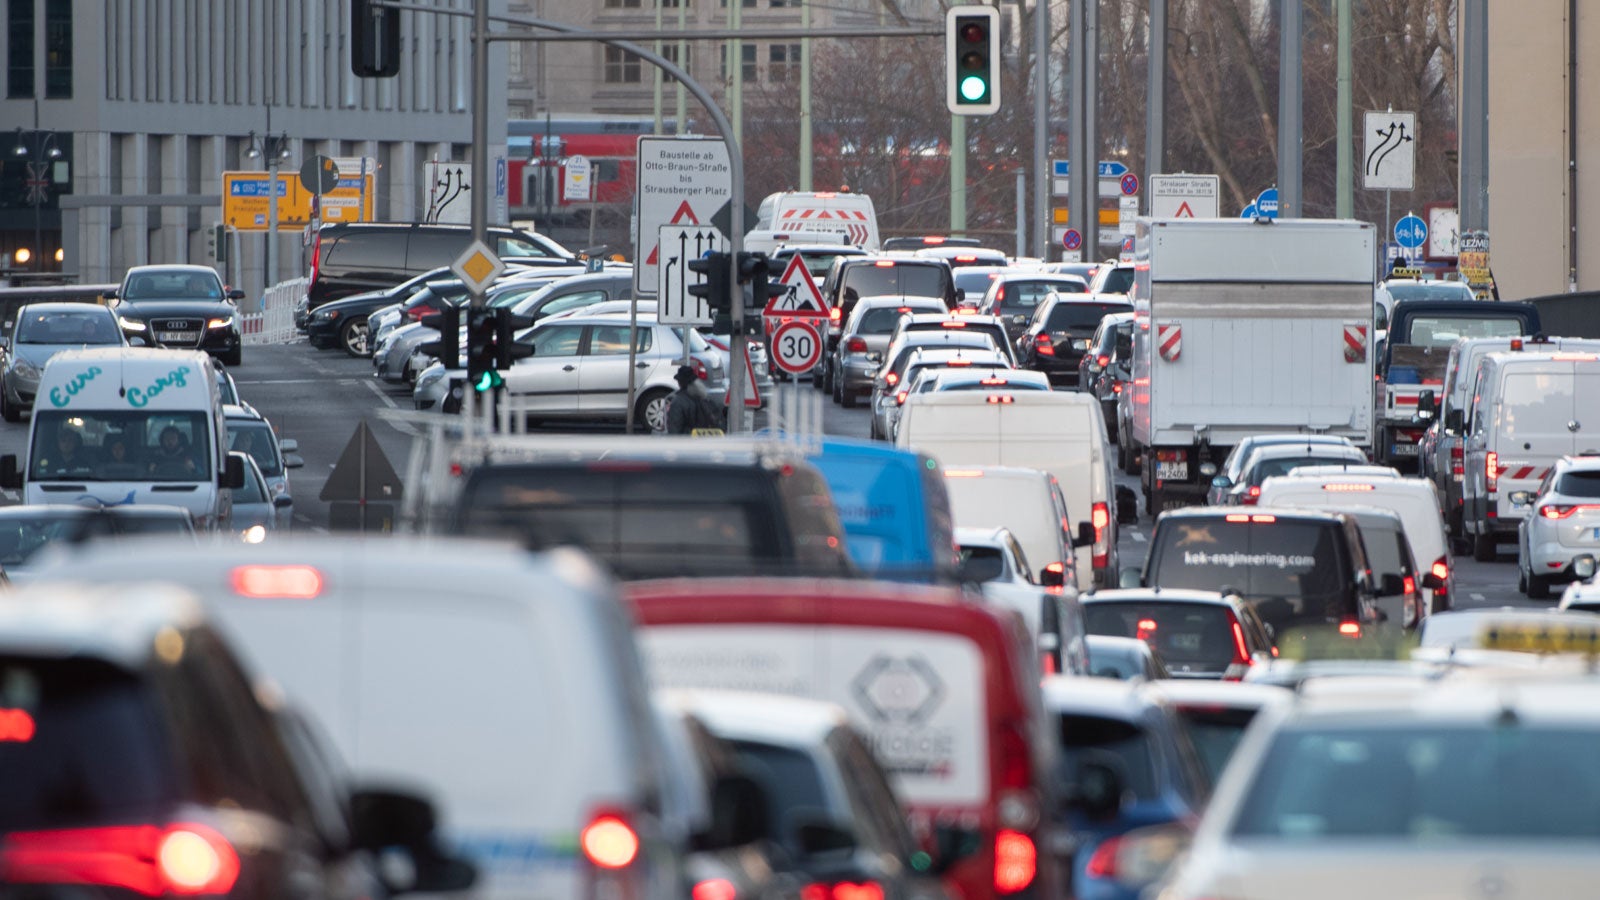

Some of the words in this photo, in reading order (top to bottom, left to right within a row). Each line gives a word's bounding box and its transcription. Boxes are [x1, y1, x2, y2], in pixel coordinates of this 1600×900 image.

[660, 150, 701, 160] Baustelle
[703, 151, 714, 160] ab
[645, 161, 728, 173] Otto-Braun-Straße
[679, 174, 692, 183] bis
[1191, 180, 1211, 188] Straße
[645, 184, 702, 196] Strausberger
[705, 186, 727, 196] Platz
[593, 259, 602, 271] P
[783, 335, 811, 359] 30
[49, 365, 103, 408] Euro
[126, 365, 191, 408] Cargo
[1183, 550, 1316, 568] kek-engineering.com
